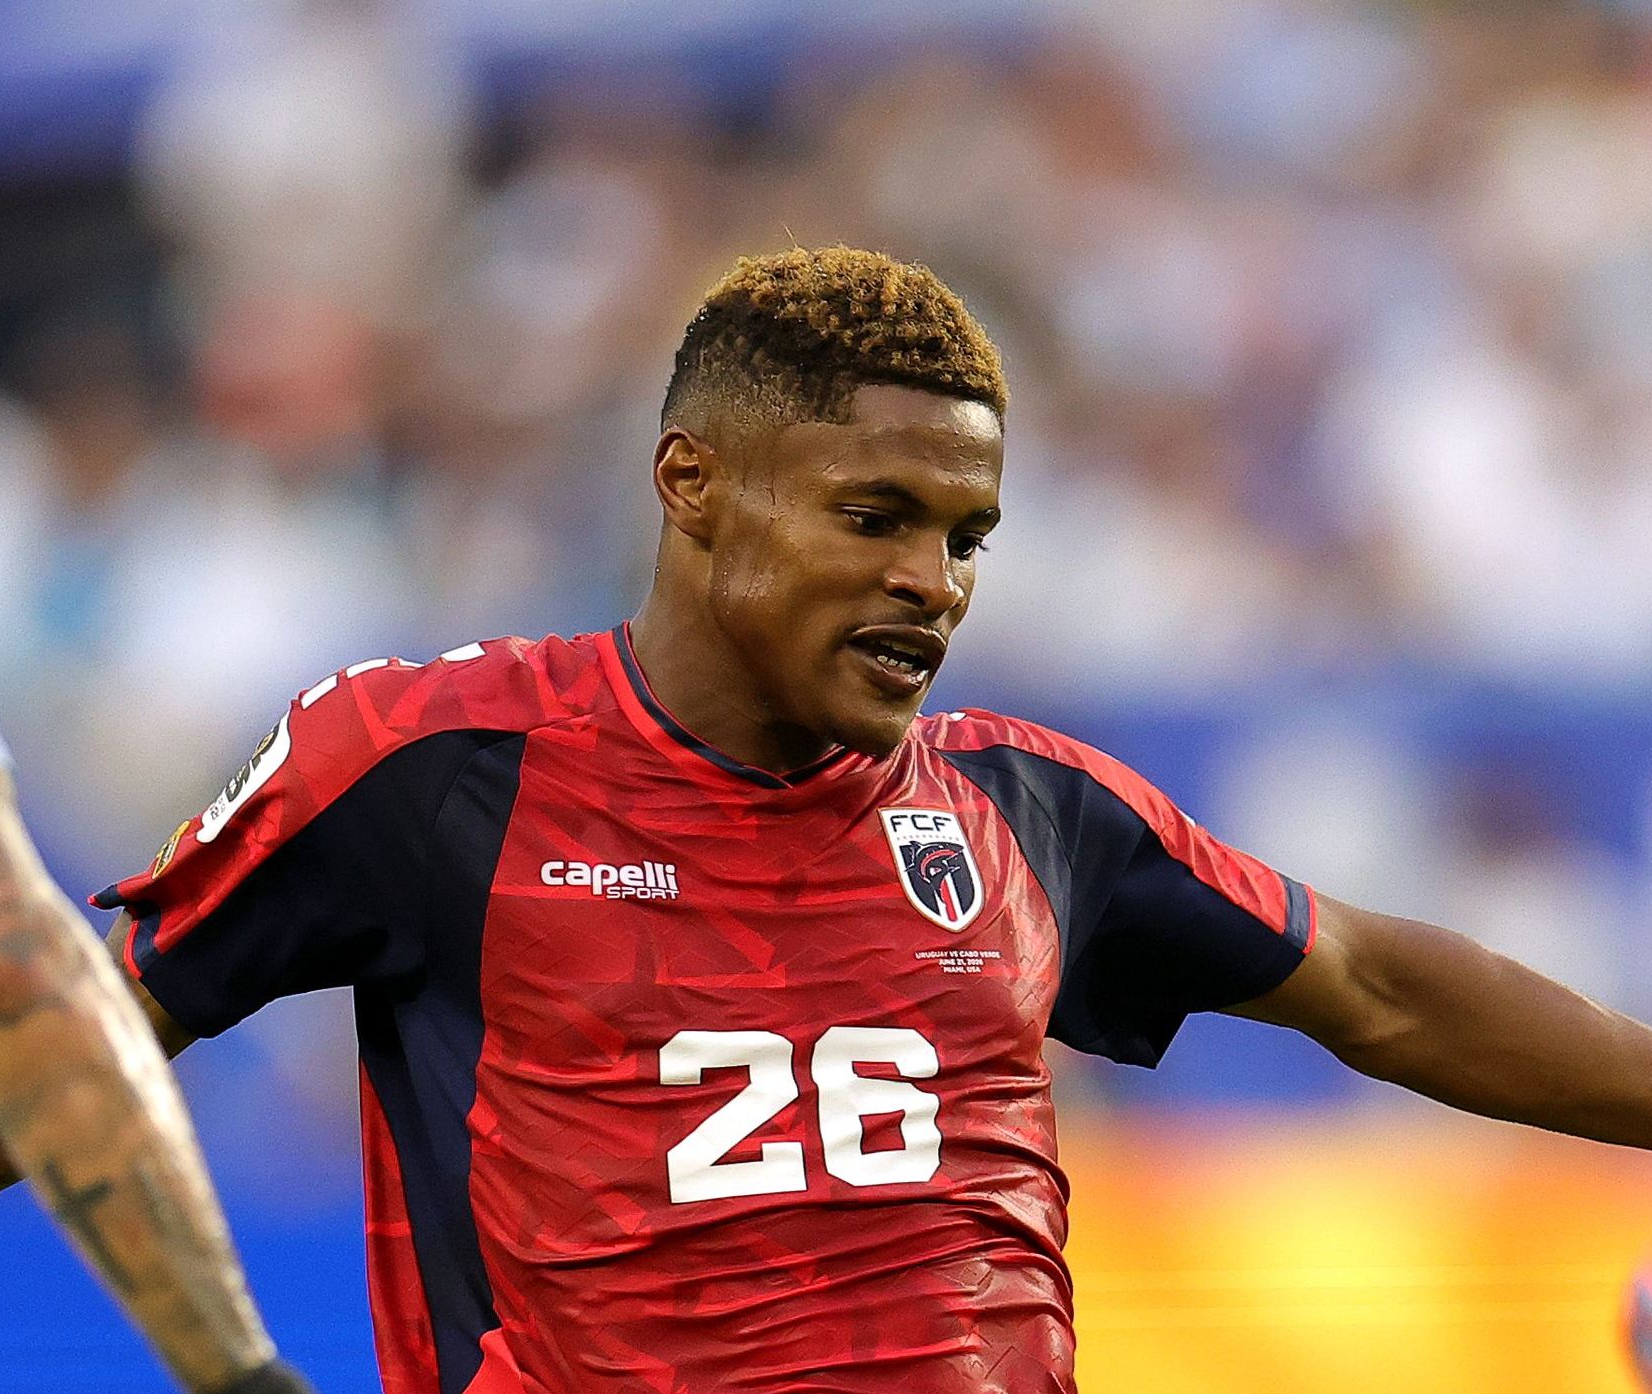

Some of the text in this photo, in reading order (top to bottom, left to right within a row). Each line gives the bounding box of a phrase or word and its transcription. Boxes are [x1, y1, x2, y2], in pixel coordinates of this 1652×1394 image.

[889, 814, 952, 833] FCF
[540, 860, 679, 896] capelli
[606, 886, 680, 900] SPORT
[914, 950, 949, 960] URUGUAY
[949, 950, 959, 959] VS
[959, 950, 979, 959] CABO
[938, 958, 956, 966] JUNE
[659, 1025, 944, 1205] 26
